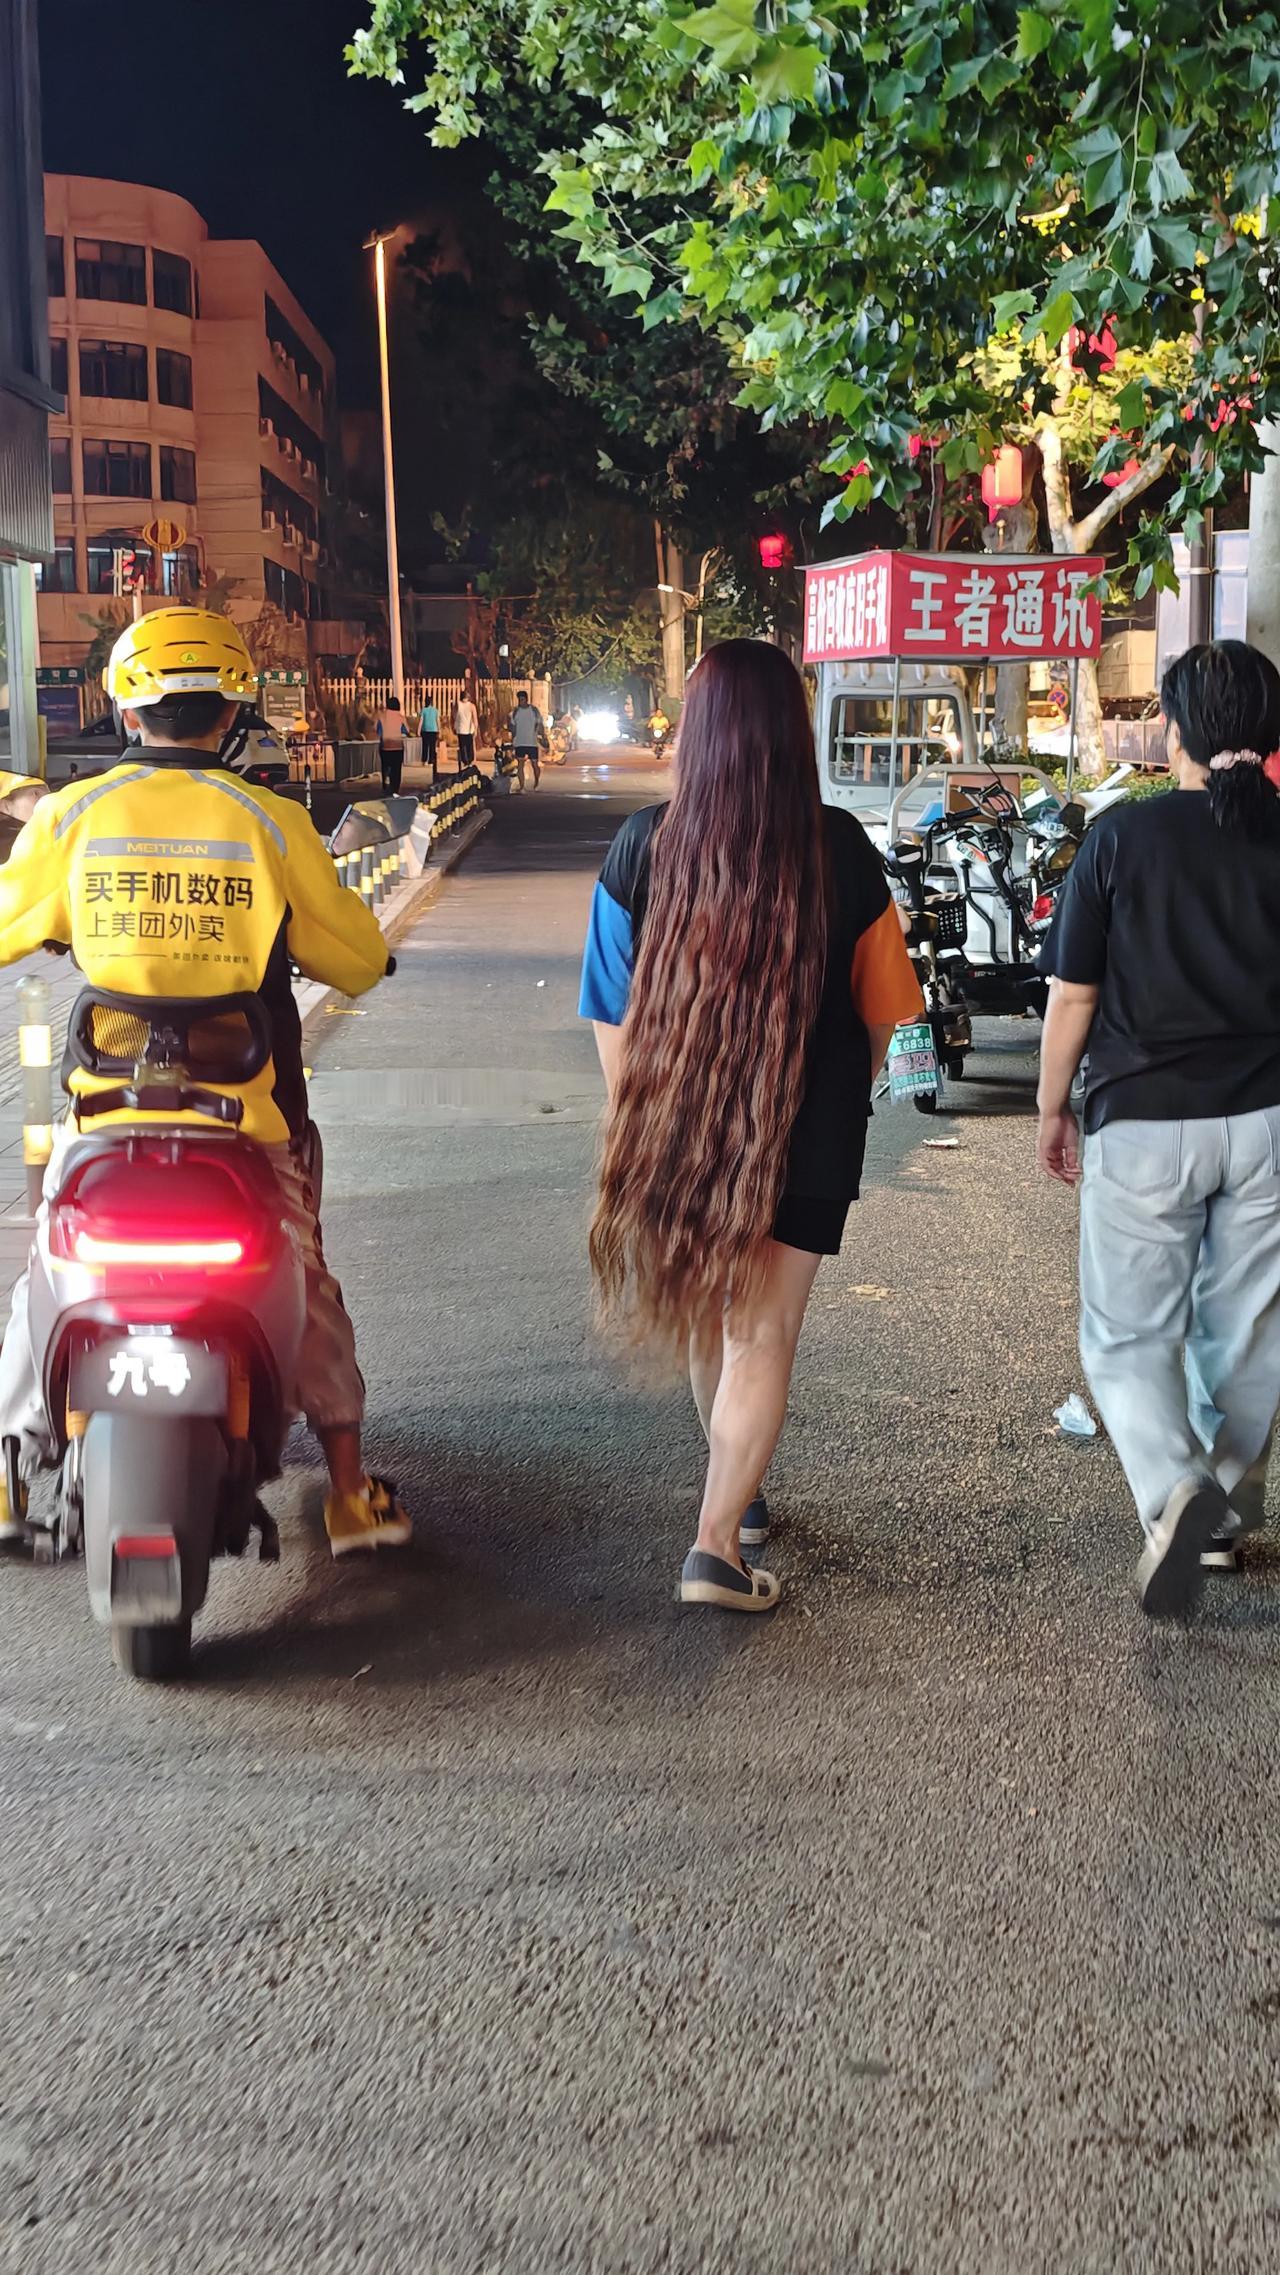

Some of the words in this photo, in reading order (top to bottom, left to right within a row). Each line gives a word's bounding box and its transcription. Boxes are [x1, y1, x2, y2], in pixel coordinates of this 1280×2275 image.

[807, 566, 888, 653] 高价回收废旧手机
[904, 568, 1094, 648] 王者通讯
[127, 842, 209, 854] MEITUAN
[85, 871, 253, 909] 买手机数码
[87, 912, 225, 942] 上美团外卖
